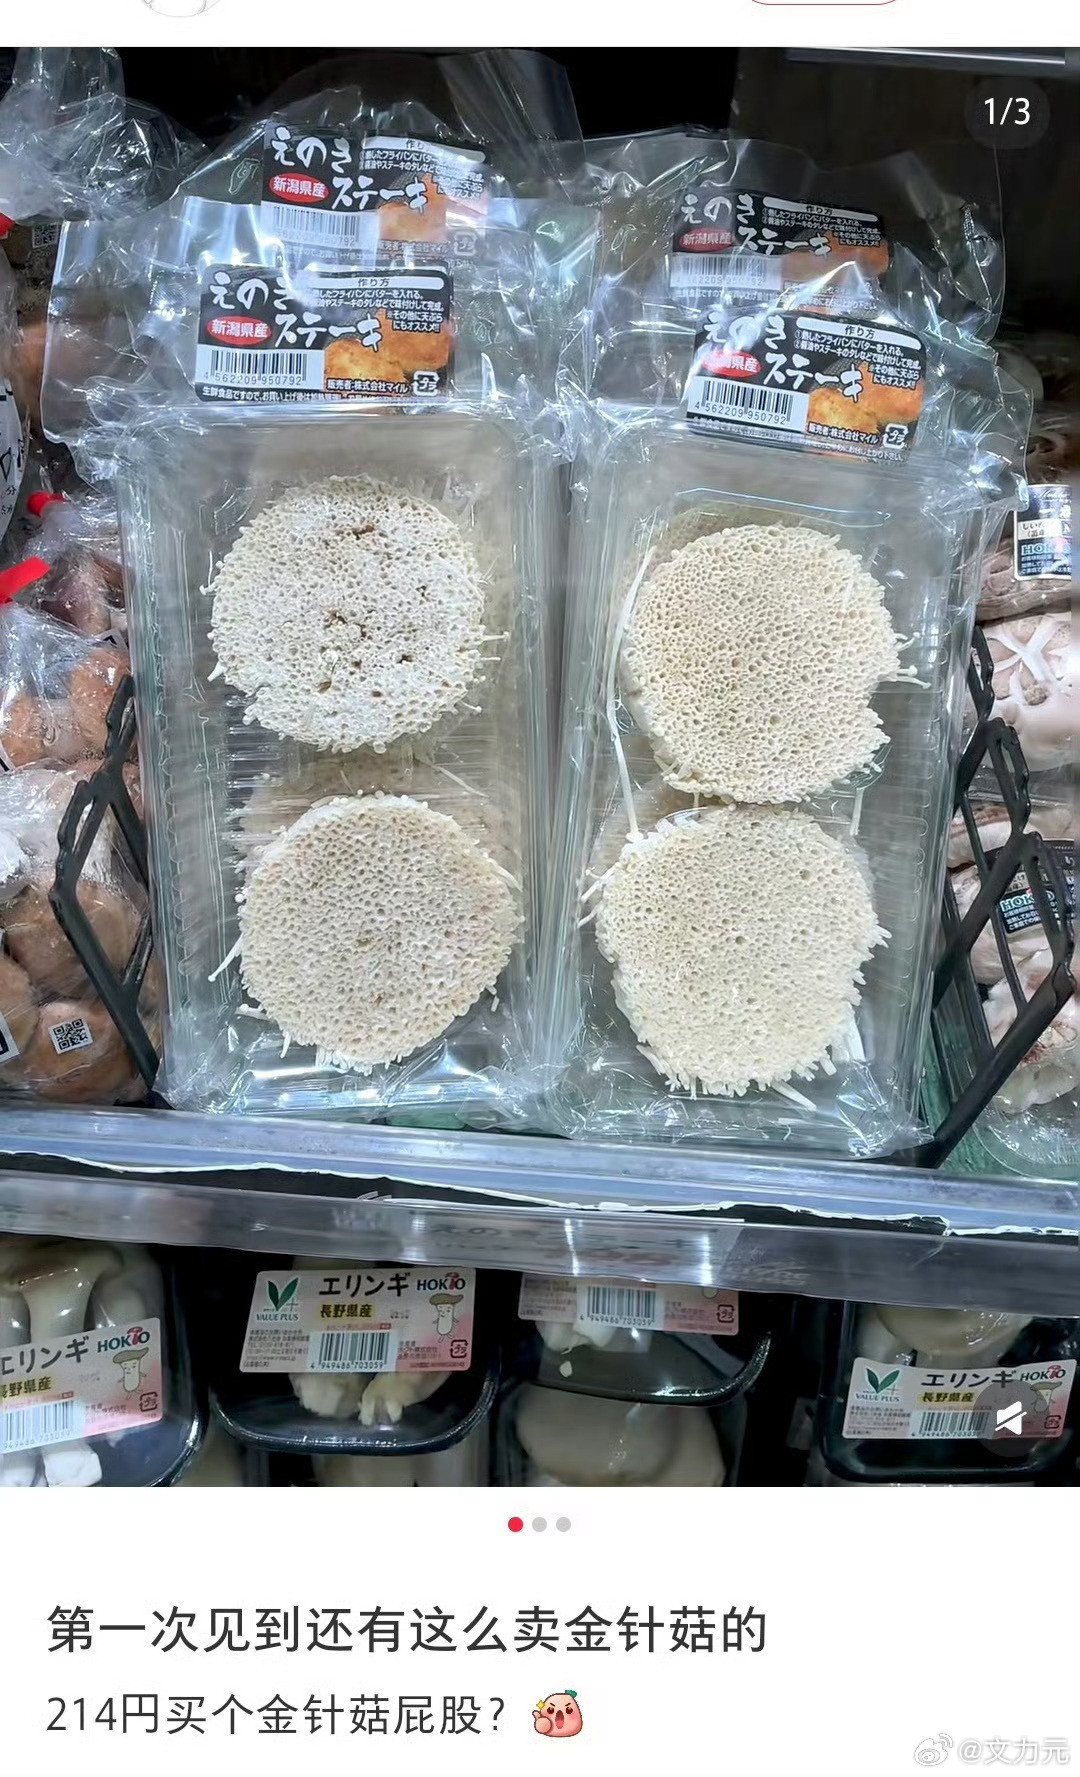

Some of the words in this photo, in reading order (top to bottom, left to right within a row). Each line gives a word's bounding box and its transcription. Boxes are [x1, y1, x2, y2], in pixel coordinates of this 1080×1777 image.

[271, 125, 352, 174] えのき
[272, 175, 328, 198] 新潟県産
[332, 175, 429, 214] ステーキ
[681, 193, 756, 224] えのき
[683, 231, 733, 245] 新潟県産
[738, 226, 832, 258] ステーキ
[358, 278, 390, 287] 作り方
[211, 319, 268, 338] 新潟県産
[275, 311, 382, 353] ステーキ
[703, 311, 787, 350] えのき
[844, 325, 876, 340] 作り方
[203, 371, 209, 380] 4
[215, 371, 257, 386] 562209
[261, 374, 302, 386] 950792
[419, 378, 438, 391] プラ
[763, 353, 864, 402] ステーキ
[694, 401, 700, 410] 4
[704, 402, 744, 418] 562209
[747, 409, 787, 425] 950792
[888, 429, 906, 444] プラ
[1000, 895, 1036, 912] HOK
[319, 1272, 411, 1298] エリンギ
[256, 1313, 279, 1321] VALUE
[280, 1313, 299, 1321] PLUS
[320, 1304, 373, 1318] 長野県産
[320, 1361, 351, 1370] 949486
[353, 1360, 384, 1369] 703059
[921, 1370, 1017, 1389] エリンギ
[855, 1392, 879, 1401] VALUE
[881, 1394, 900, 1402] PLUS
[921, 1392, 975, 1403] 長野県産
